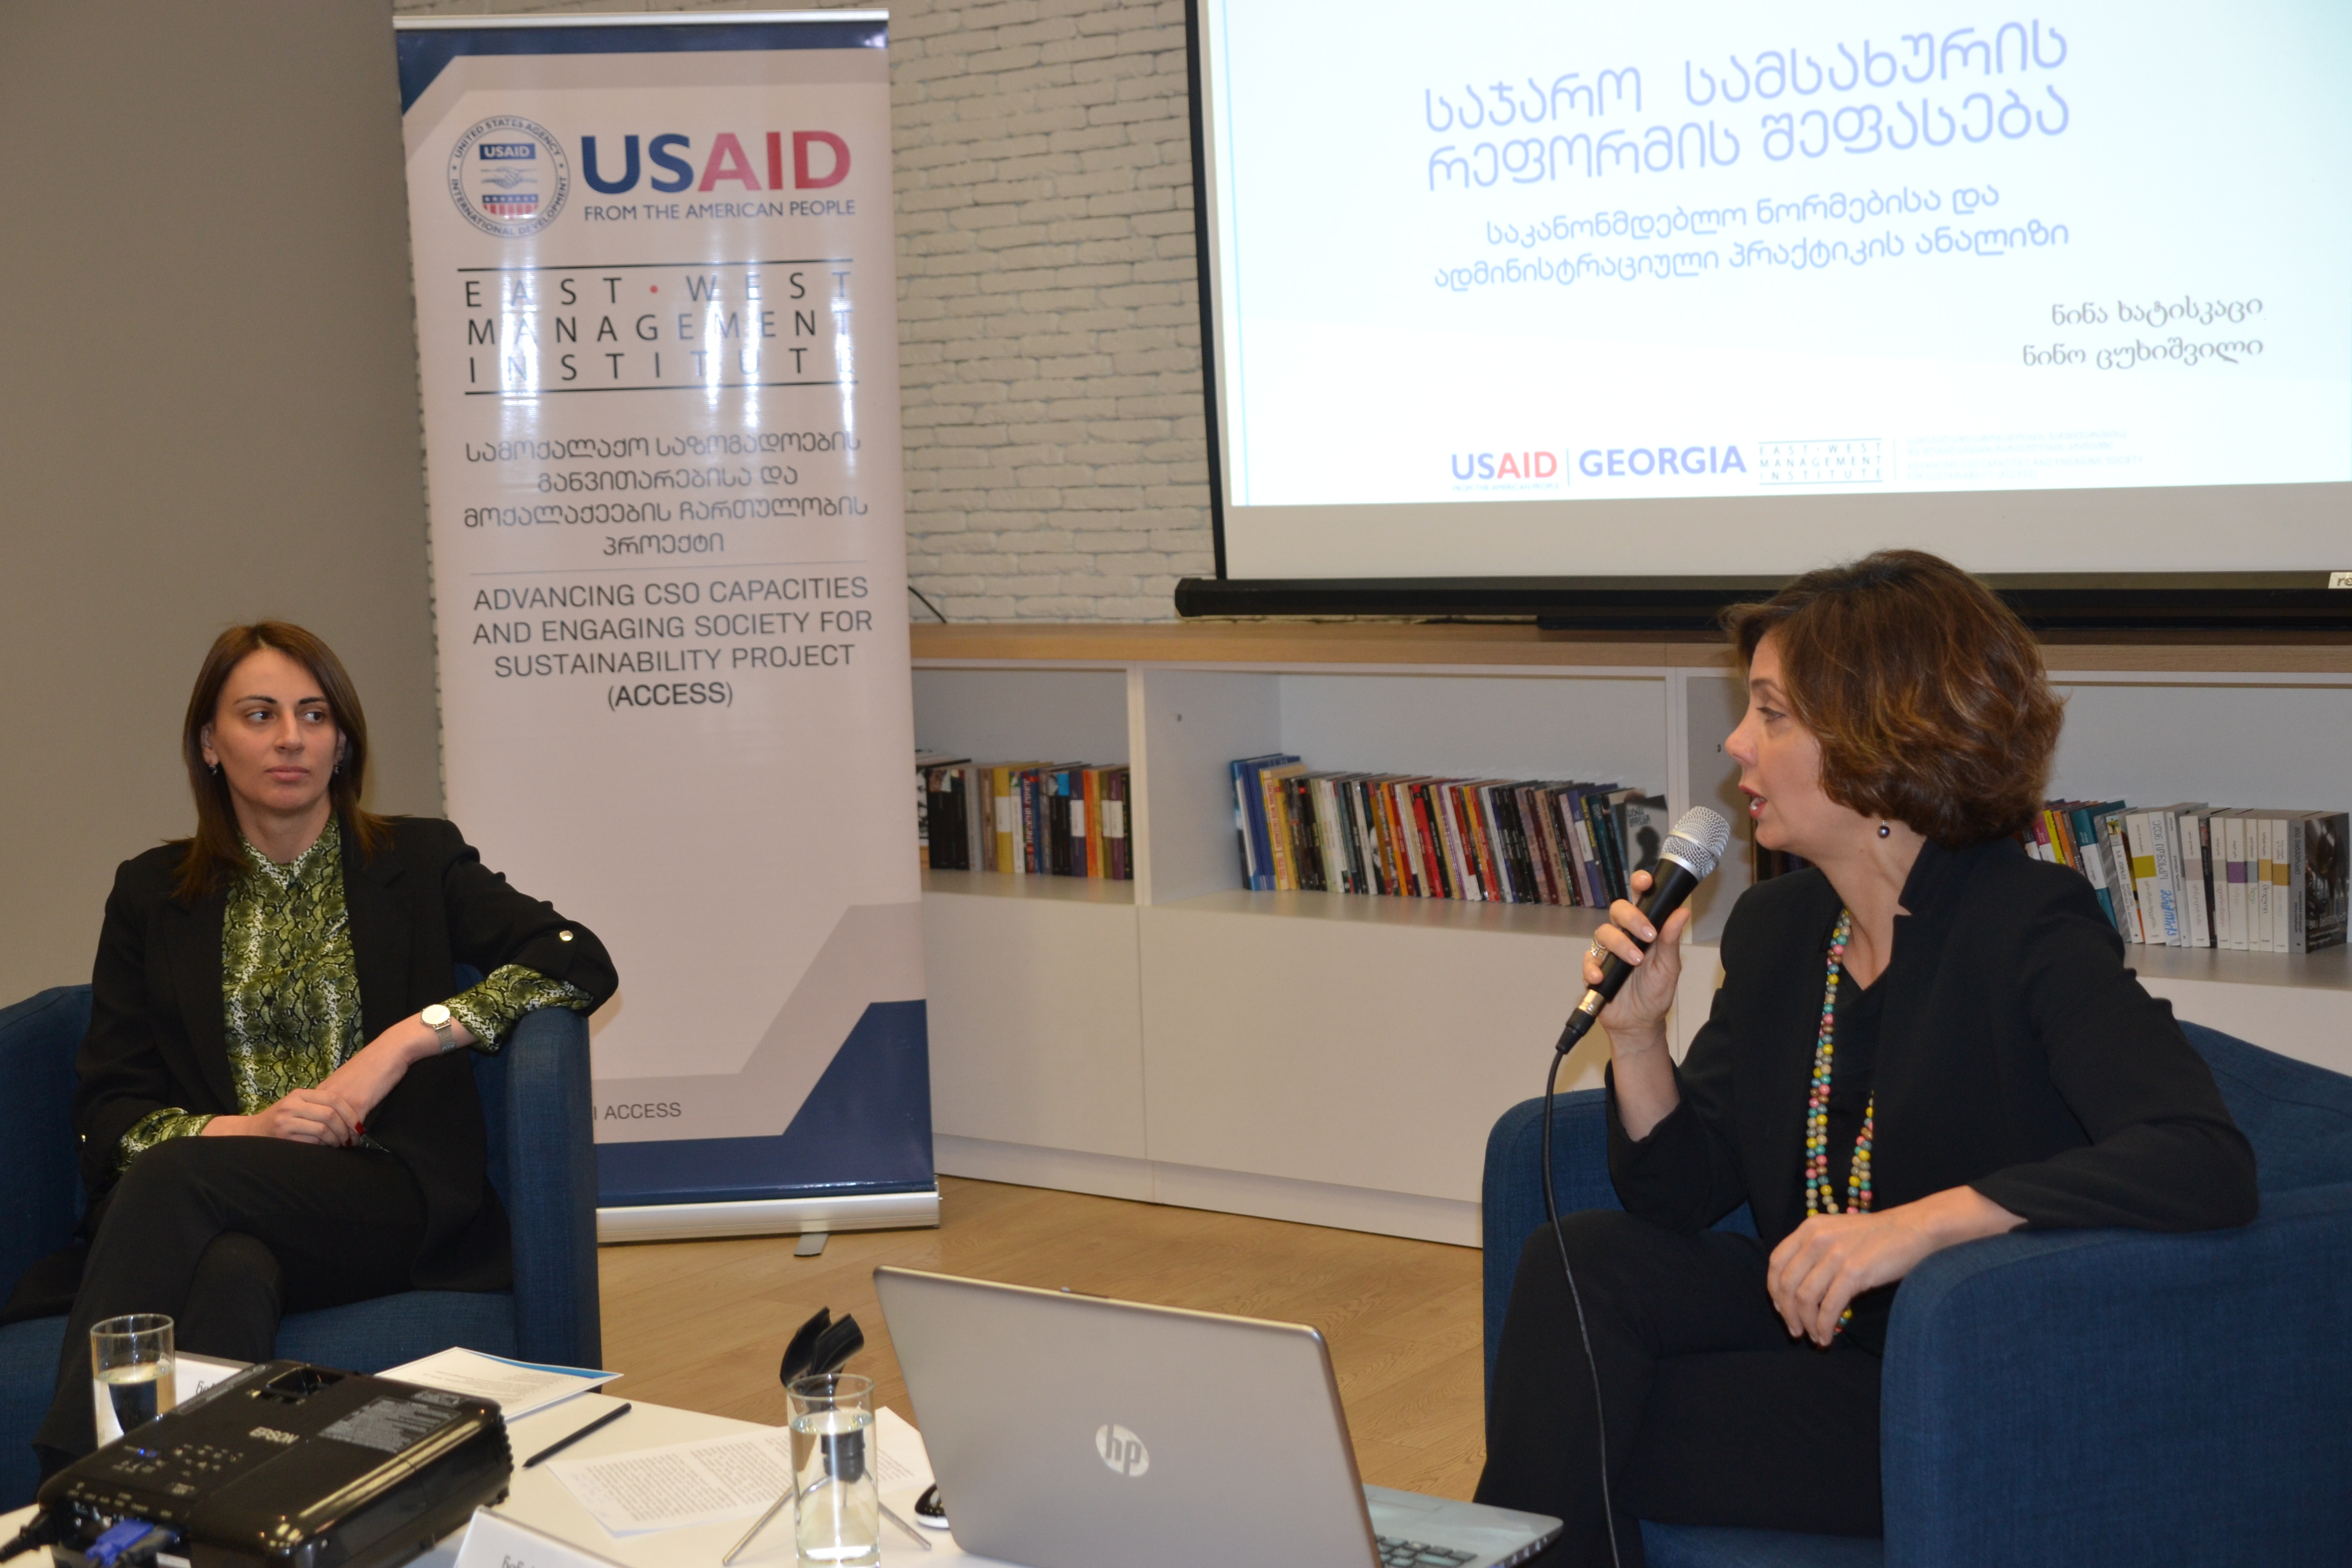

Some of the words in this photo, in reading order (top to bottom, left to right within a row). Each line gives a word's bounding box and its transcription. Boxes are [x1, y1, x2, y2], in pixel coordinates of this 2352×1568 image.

[1426, 67, 1641, 132] საჯარო
[1685, 18, 2068, 107] სამსახურის
[454, 126, 484, 158] UNITED
[485, 118, 523, 129] STATES
[525, 123, 561, 156] AGENCY
[484, 145, 530, 157] USAID
[1429, 120, 1740, 191] რეფორმის
[1761, 84, 2069, 161] შეფასება
[580, 130, 852, 195] USAID
[585, 203, 638, 222] FROM
[643, 202, 681, 220] THE
[686, 200, 785, 219] AMERICAN
[790, 198, 856, 217] PEOPLE
[1486, 206, 1747, 249] საკანონმდებლო
[1757, 186, 1942, 225] ნორმებისა
[1952, 185, 2000, 215] და
[1434, 250, 1719, 291] ადმინისტრაციული
[1728, 230, 1905, 270] პრაქტიკის
[1916, 218, 2069, 256] ანალიზი
[468, 309, 854, 347] MANAGEMENT
[2051, 302, 2109, 326] ნინა
[2117, 295, 2264, 328] ხატისკაცი
[2022, 343, 2087, 366] ნინო
[2096, 336, 2264, 371] ცუხიშვილი
[466, 436, 649, 462] სამოქალაქო
[656, 430, 861, 457] საზოგადოების
[1578, 445, 1748, 477] GEORGIA
[1760, 456, 1881, 468] MANAGEMENT
[537, 467, 752, 494] განვითარებისა
[761, 465, 798, 485] და
[1451, 450, 1559, 480] USAID
[1760, 468, 1881, 481] INSTITUTE
[464, 501, 672, 528] მოქალაქეების
[679, 495, 868, 521] ჩართულობის
[603, 531, 725, 556] პროექტი
[474, 584, 635, 610] ADVANCING
[644, 582, 700, 605] CSO
[709, 576, 869, 603] CAPACITIES
[473, 622, 531, 645] AND
[543, 616, 685, 642] ENGAGING
[695, 612, 811, 638] SOCIETY
[821, 610, 873, 632] FOR
[495, 648, 722, 677] SUSTAINABILITY
[732, 644, 856, 669] PROJECT
[607, 681, 734, 711] (ACCESS)
[604, 1102, 682, 1120] ACCESS
[249, 1426, 300, 1444] EPSON
[1105, 1423, 1142, 1477] hp
